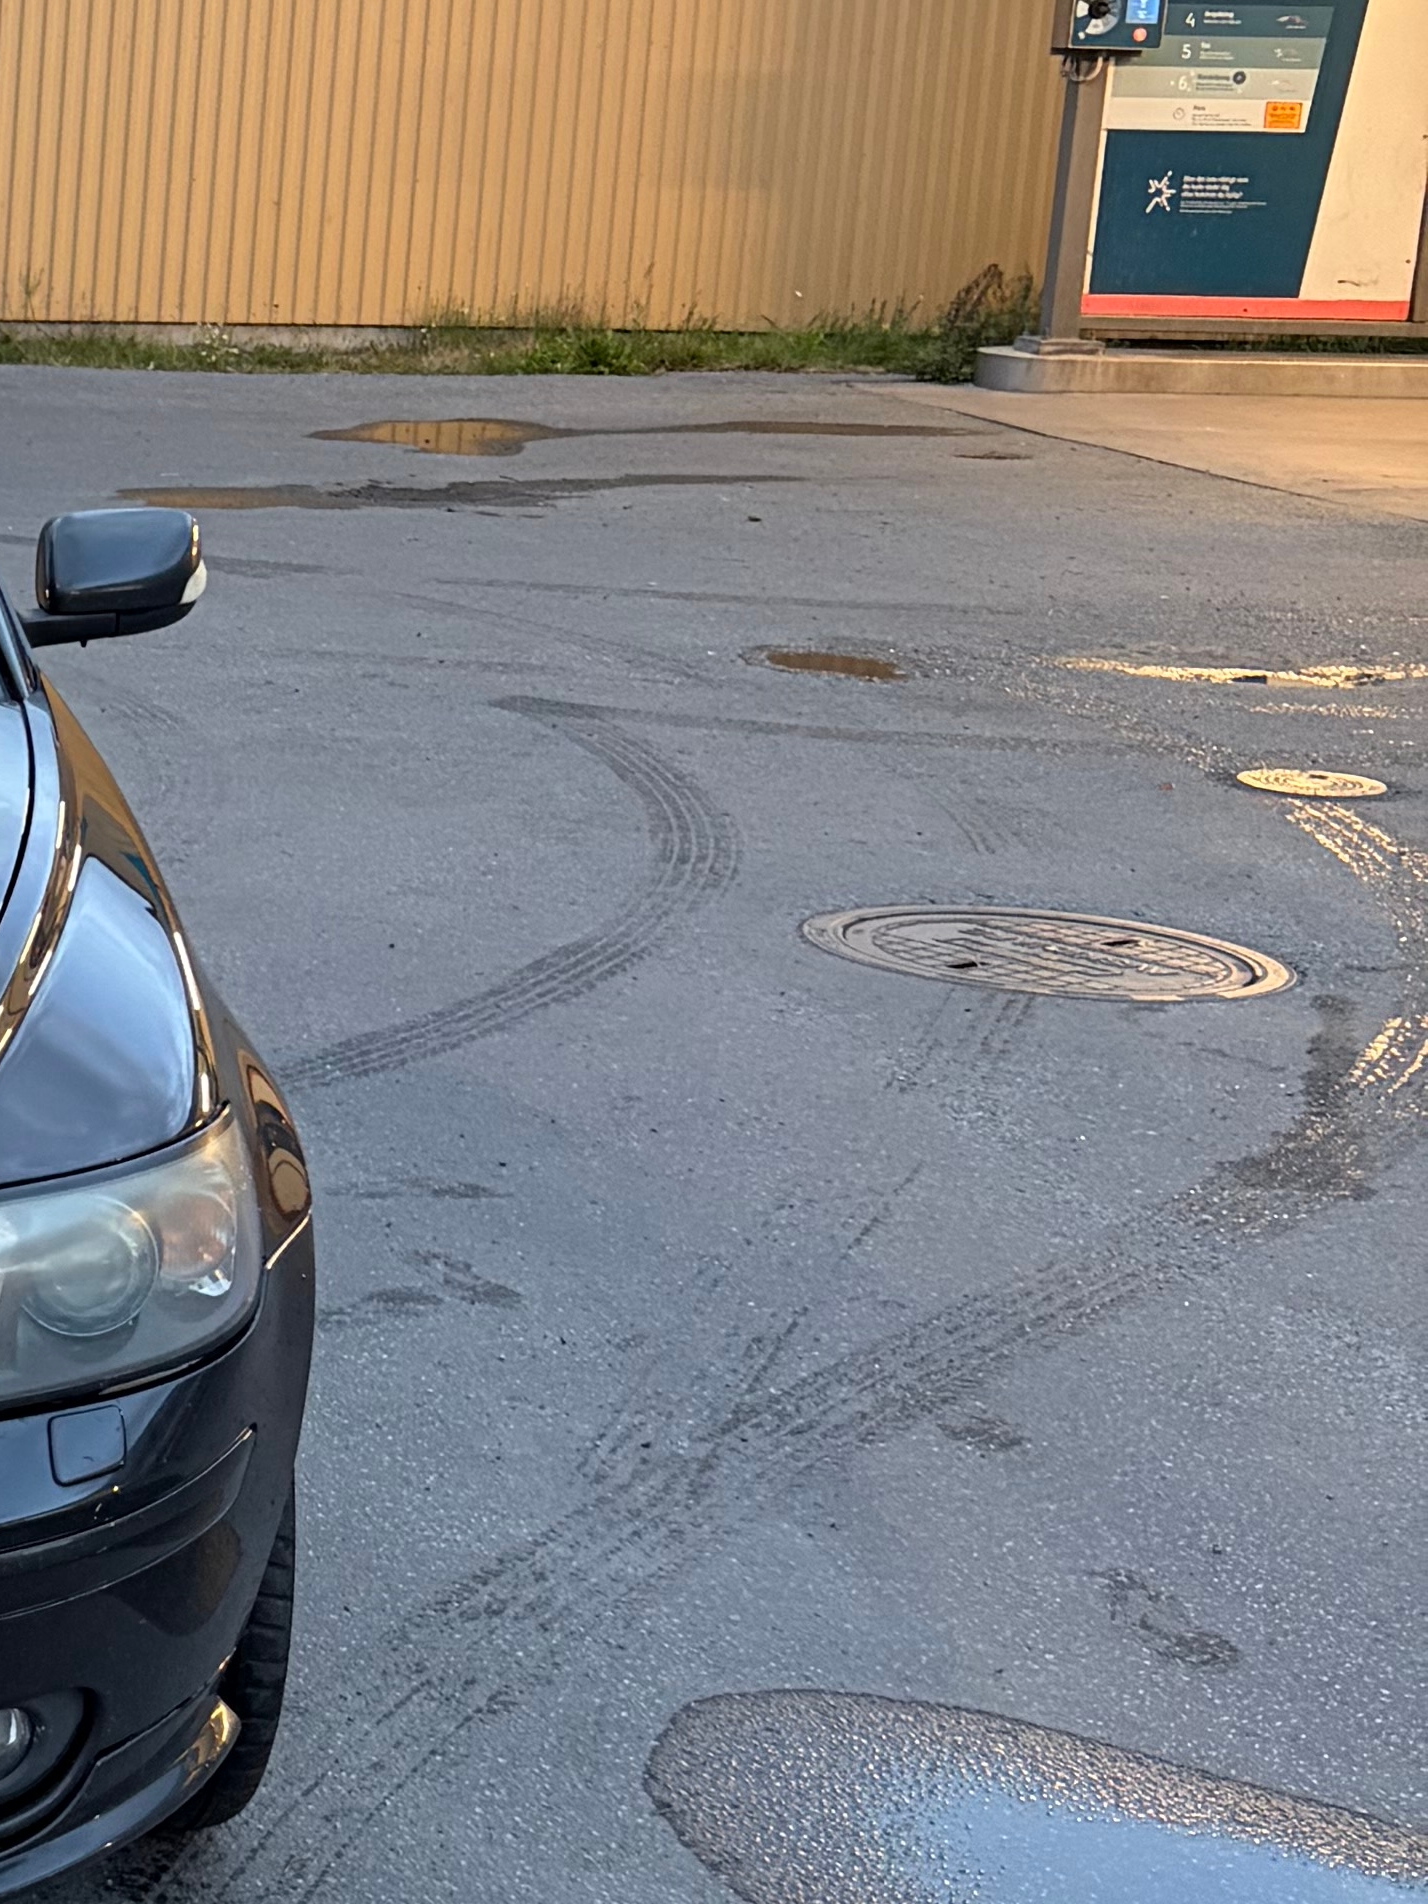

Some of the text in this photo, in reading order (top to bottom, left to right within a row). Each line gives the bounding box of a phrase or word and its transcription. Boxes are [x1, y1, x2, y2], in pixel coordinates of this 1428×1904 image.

[1185, 12, 1196, 28] 4
[1181, 43, 1192, 59] 5
[1178, 75, 1188, 91] 6
